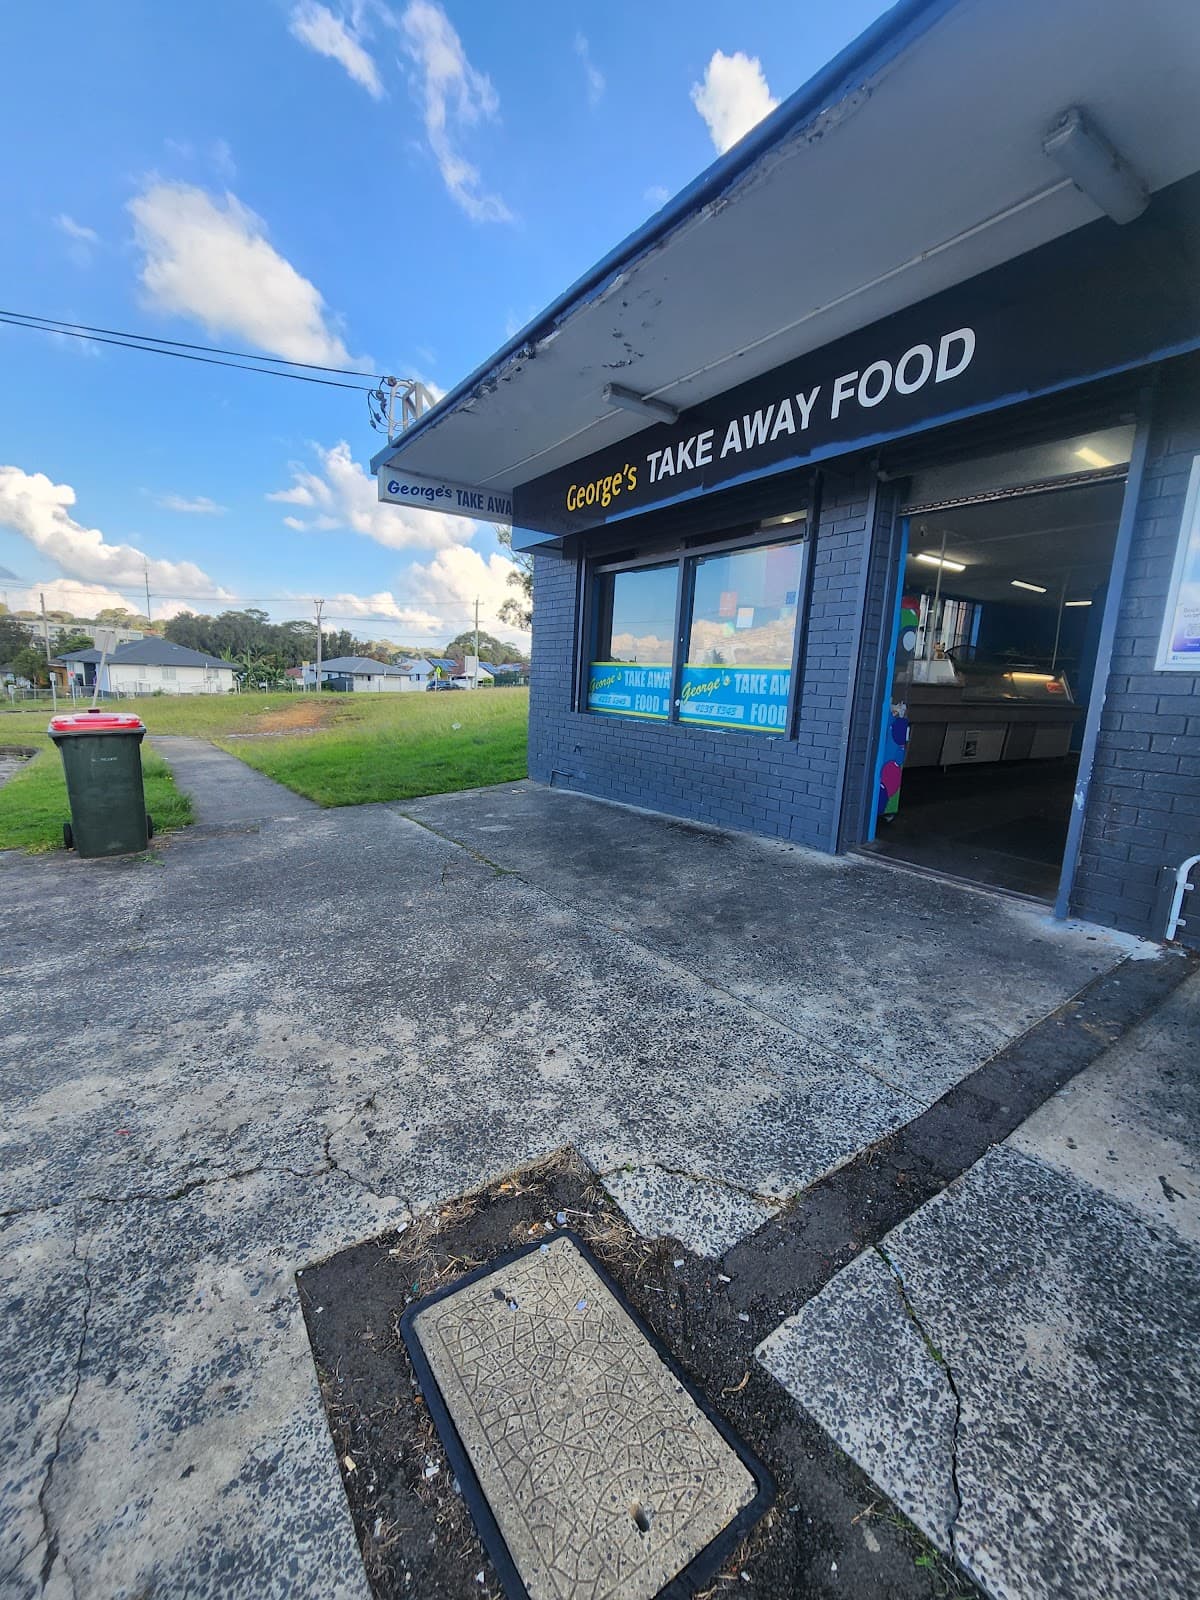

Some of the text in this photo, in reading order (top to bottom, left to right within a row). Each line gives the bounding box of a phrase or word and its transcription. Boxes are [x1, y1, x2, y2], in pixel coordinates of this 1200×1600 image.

[566, 327, 976, 512] George's TAKE AWAY FOOD
[387, 480, 452, 501] George's
[456, 489, 484, 510] TAKE
[590, 668, 672, 695] George's TAKE AWA
[681, 670, 731, 705] George's
[734, 673, 768, 695] TAKE
[635, 694, 660, 713] FOOD
[751, 703, 788, 726] FOOD
